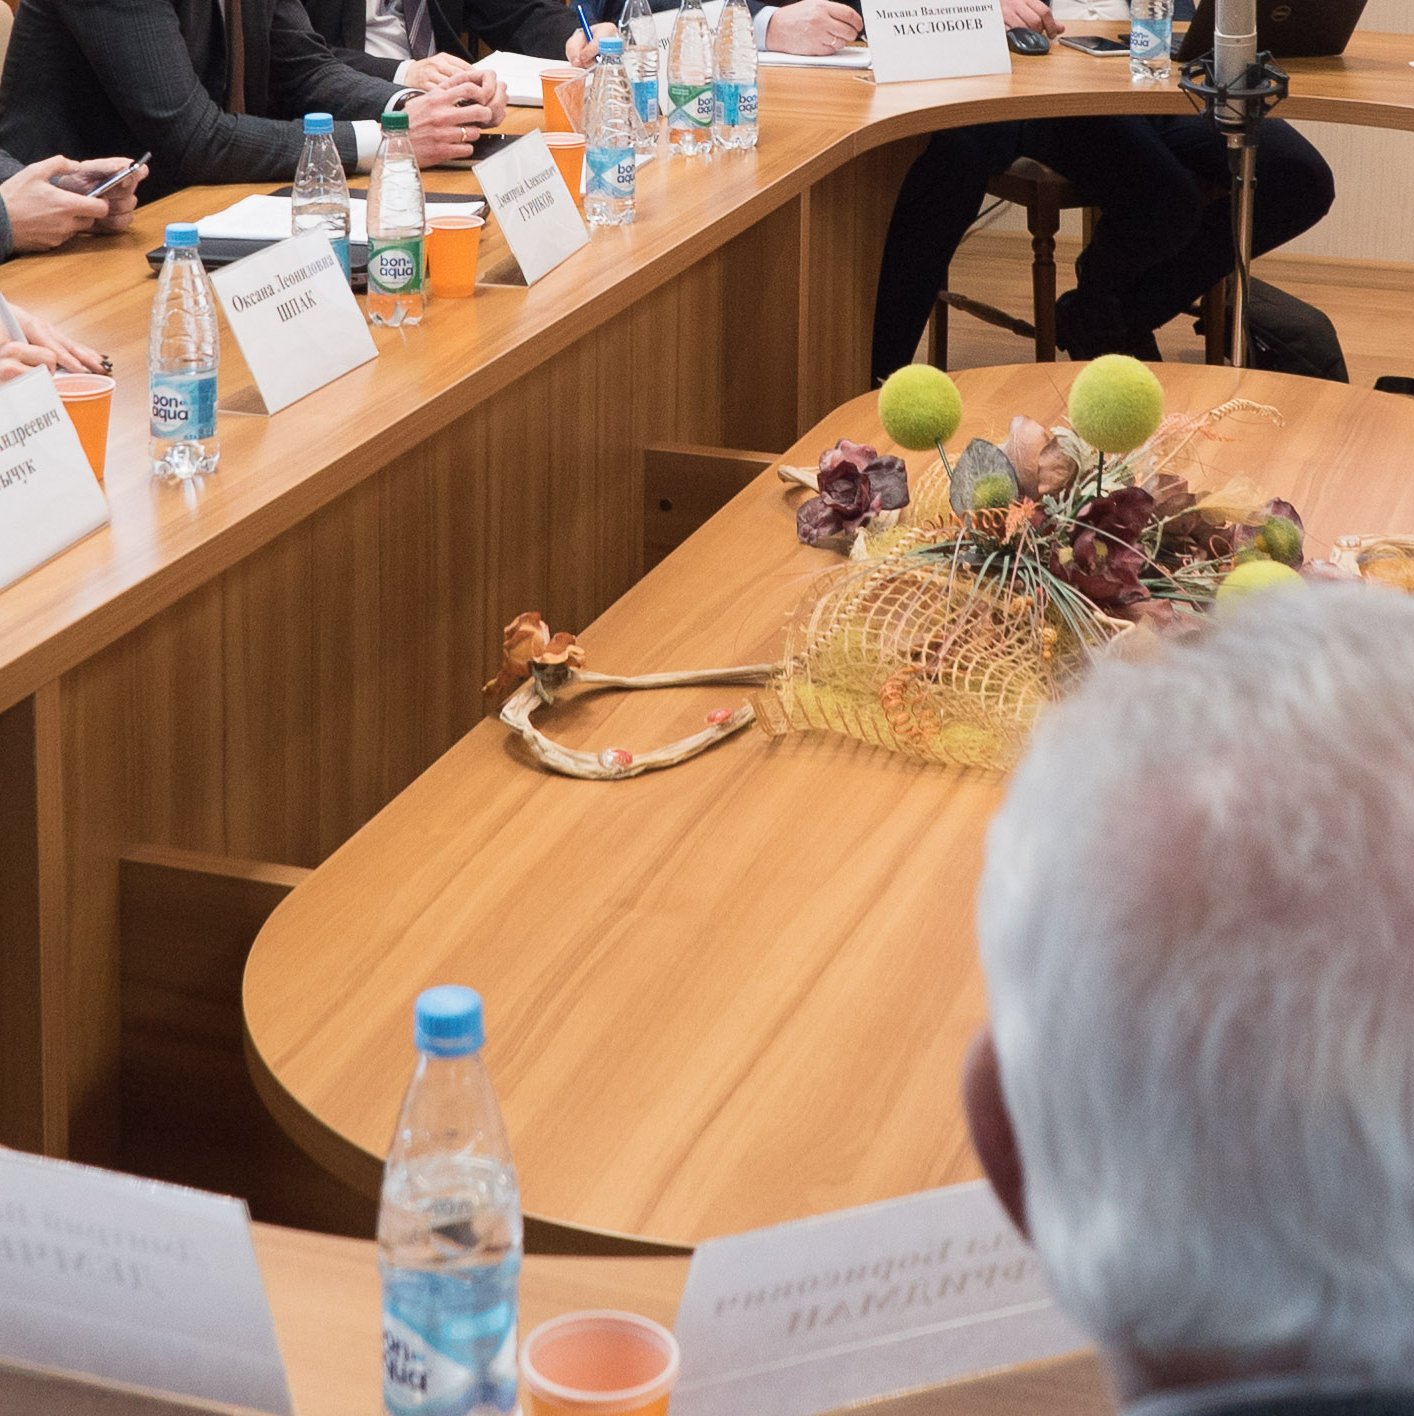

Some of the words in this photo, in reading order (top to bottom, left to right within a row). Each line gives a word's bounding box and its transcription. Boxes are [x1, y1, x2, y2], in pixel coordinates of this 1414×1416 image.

[875, 8, 919, 21] Михаил
[920, 3, 994, 17] Валентинович
[893, 18, 984, 37] МАСЛОБОЕВ
[379, 266, 414, 280] aqua
[231, 282, 276, 313] Оксана
[275, 253, 335, 293] Леонидовна
[276, 289, 318, 323] ШПАК
[152, 405, 189, 423] aqua
